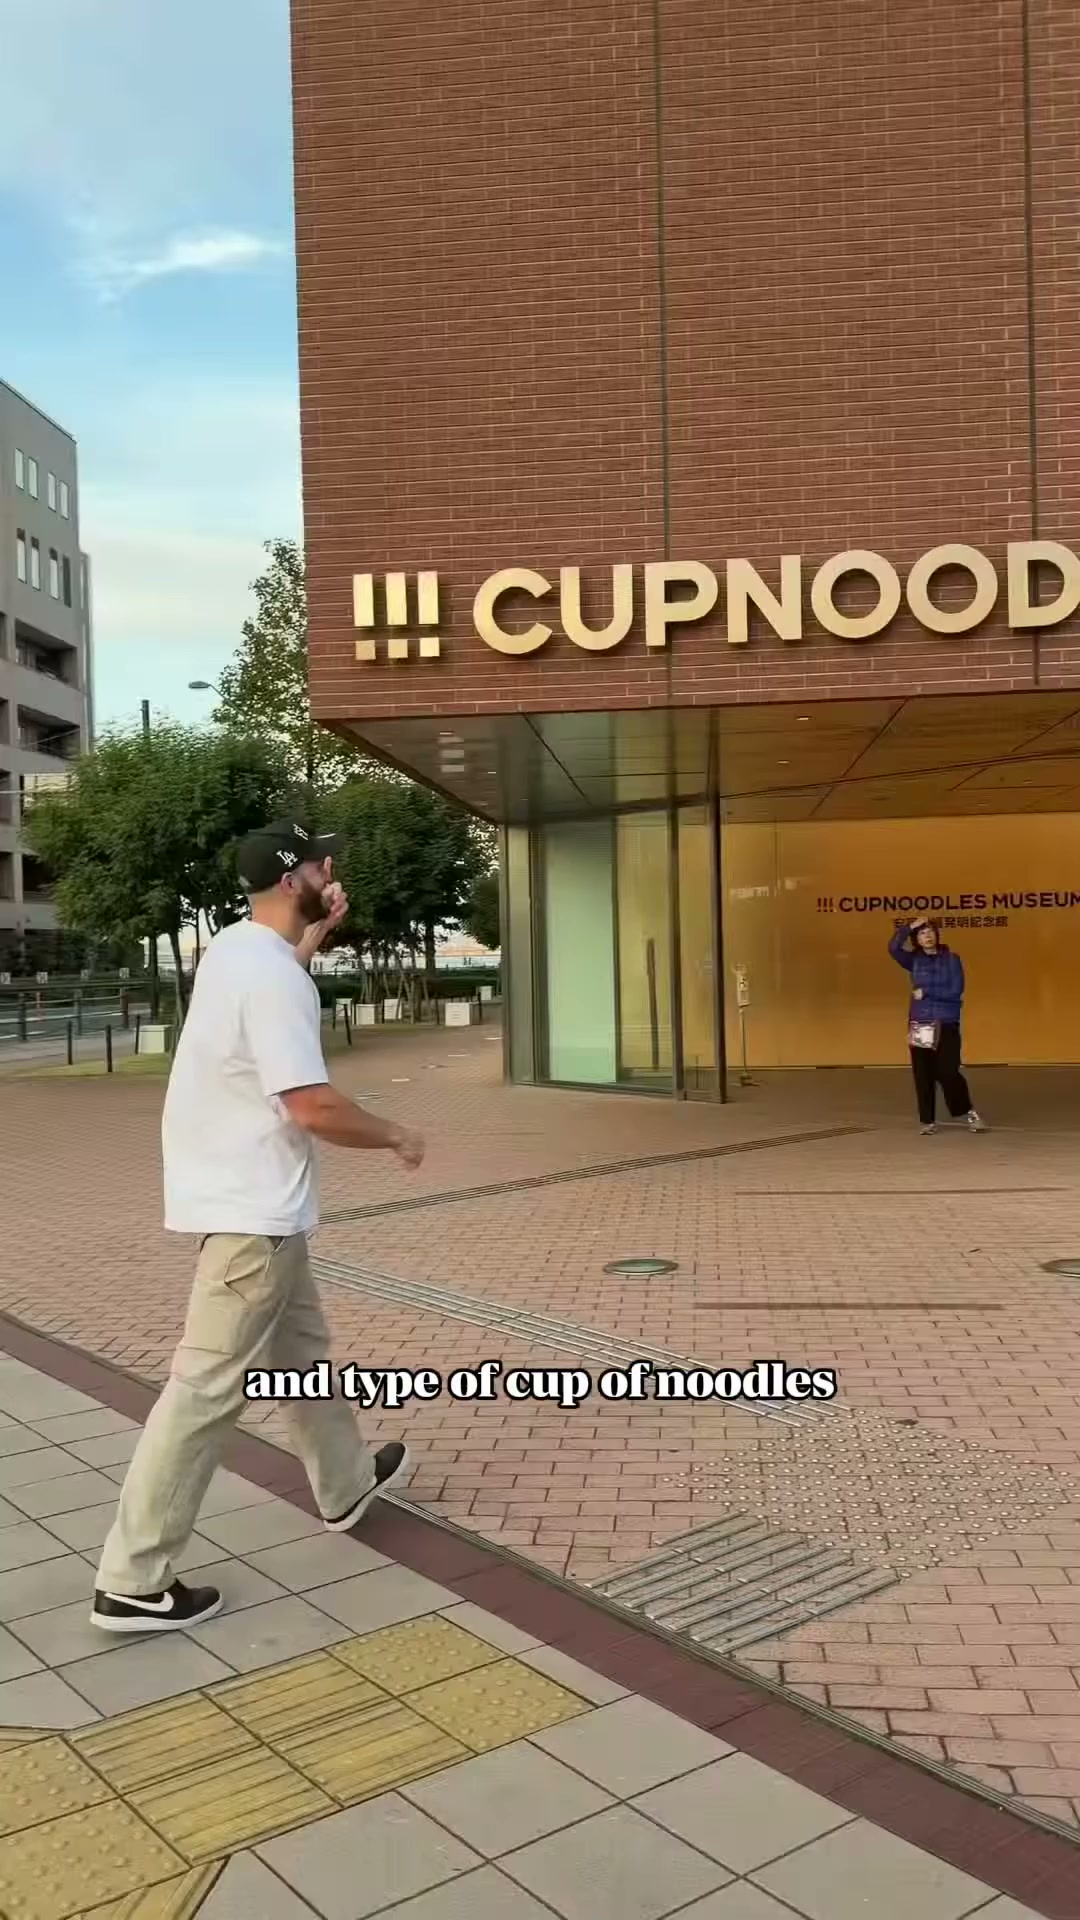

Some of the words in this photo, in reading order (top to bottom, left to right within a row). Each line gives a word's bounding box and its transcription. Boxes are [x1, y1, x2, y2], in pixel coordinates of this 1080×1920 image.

[472, 541, 1080, 655] CUPNOOD
[276, 850, 298, 867] LA
[839, 893, 987, 912] CUPNOODLES
